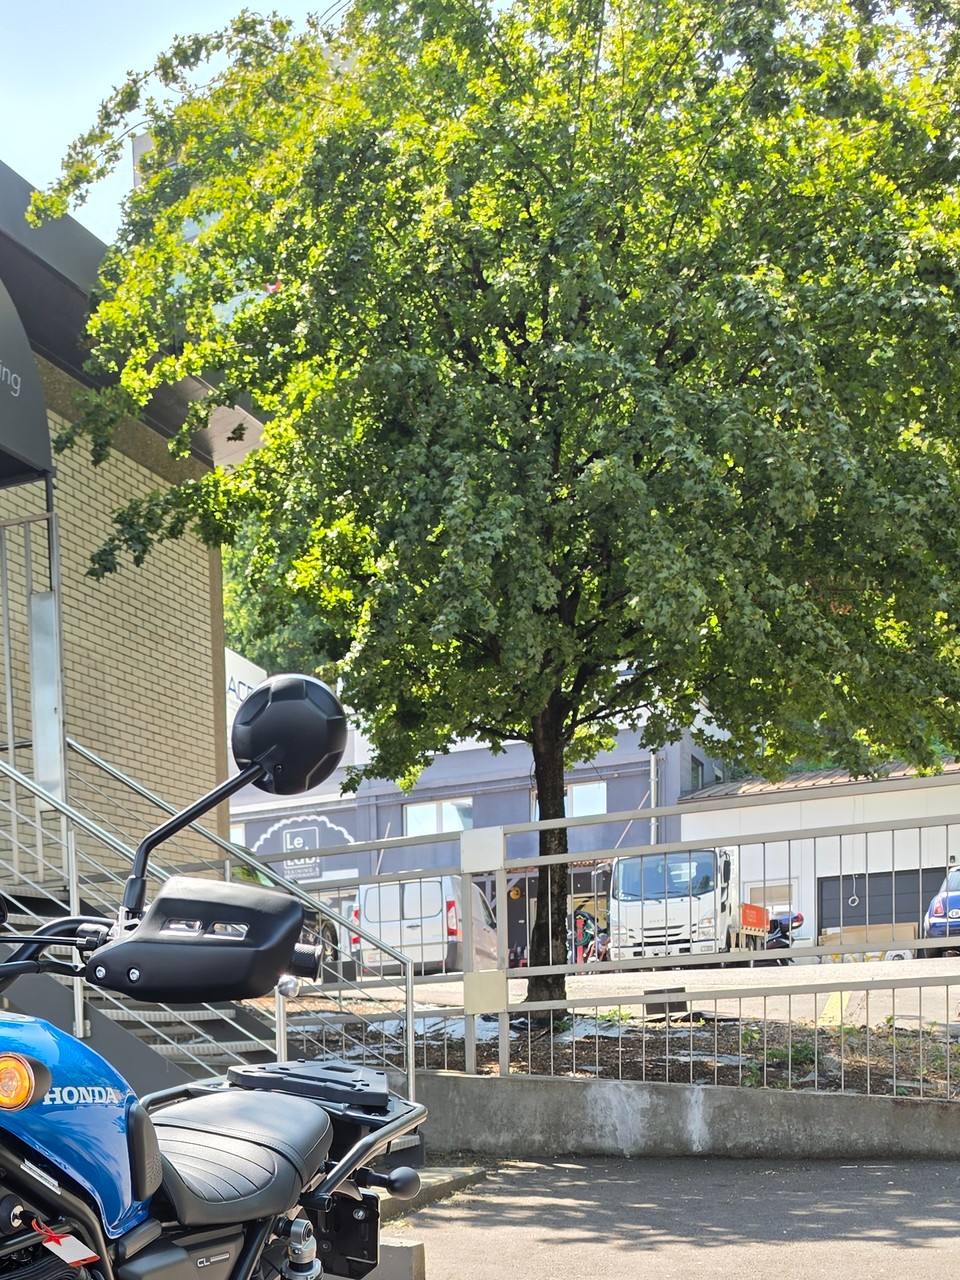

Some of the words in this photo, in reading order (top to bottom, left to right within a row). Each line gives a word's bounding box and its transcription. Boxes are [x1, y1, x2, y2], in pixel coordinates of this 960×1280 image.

[286, 833, 304, 849] Le
[42, 1086, 119, 1105] HONDA
[197, 1257, 210, 1267] CL
